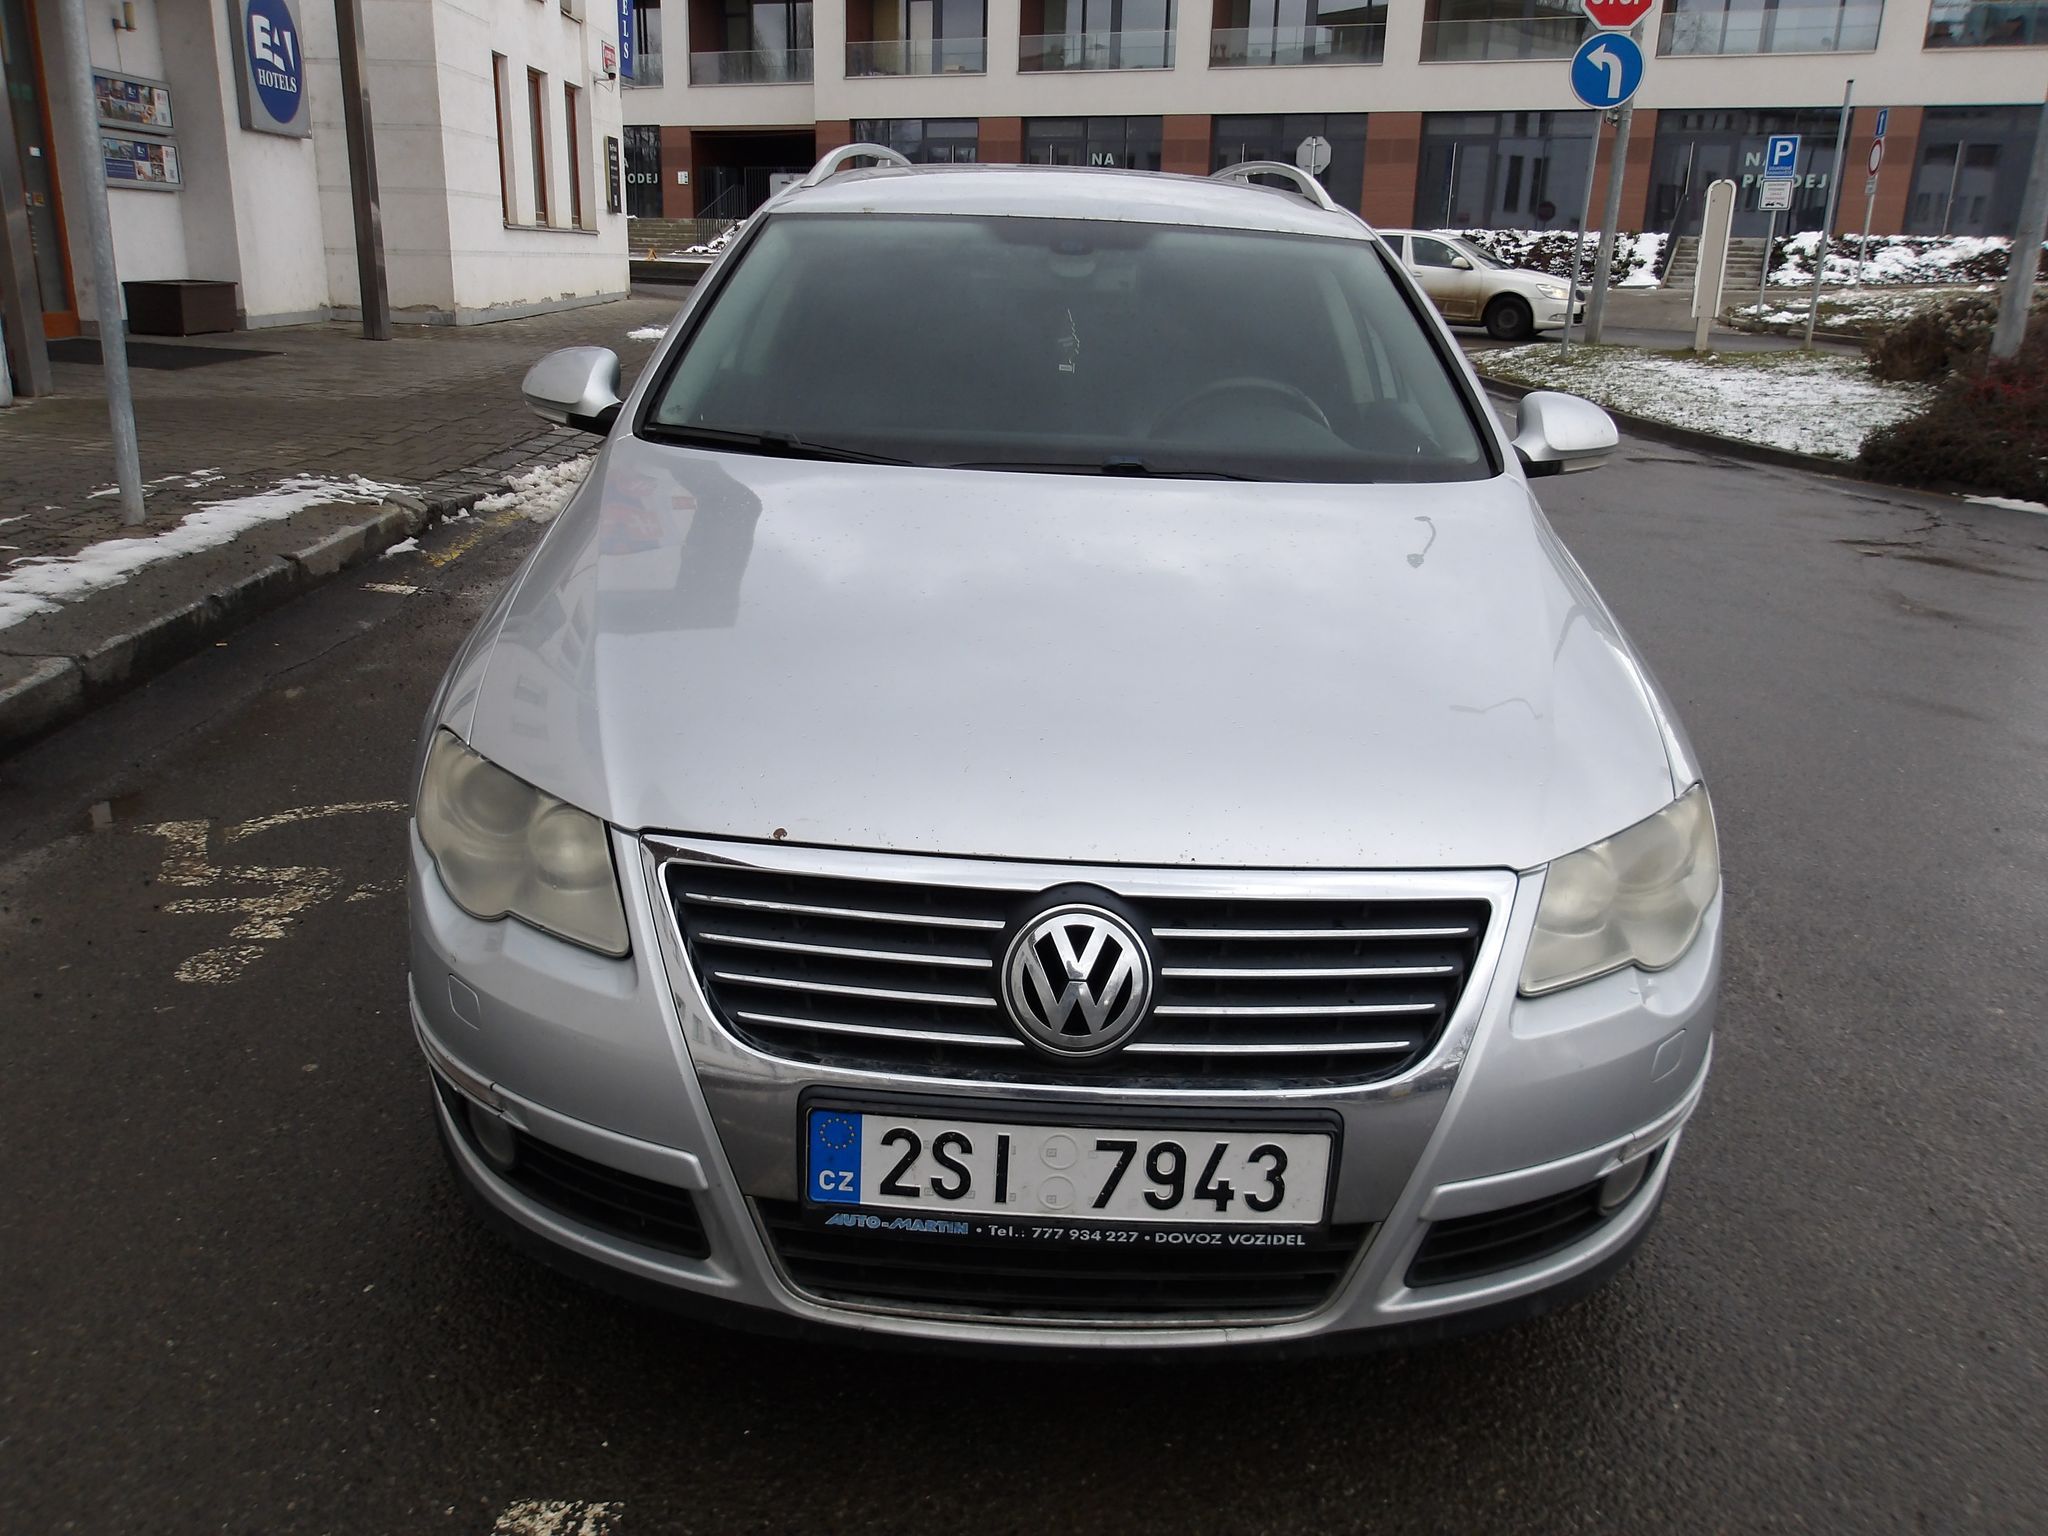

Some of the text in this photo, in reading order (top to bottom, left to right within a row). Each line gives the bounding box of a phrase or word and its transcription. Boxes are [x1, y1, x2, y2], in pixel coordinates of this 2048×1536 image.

[258, 68, 297, 93] HOTELS
[1091, 152, 1114, 166] NA
[1773, 141, 1793, 165] P
[1742, 174, 1827, 188] PDEJ
[818, 1170, 854, 1192] CZ
[879, 1128, 1288, 1213] 2SI 7943
[825, 1213, 1306, 1246] AUTO-MARTIN Tel.: 777 934 227 DOVOZ VOZIDEL
